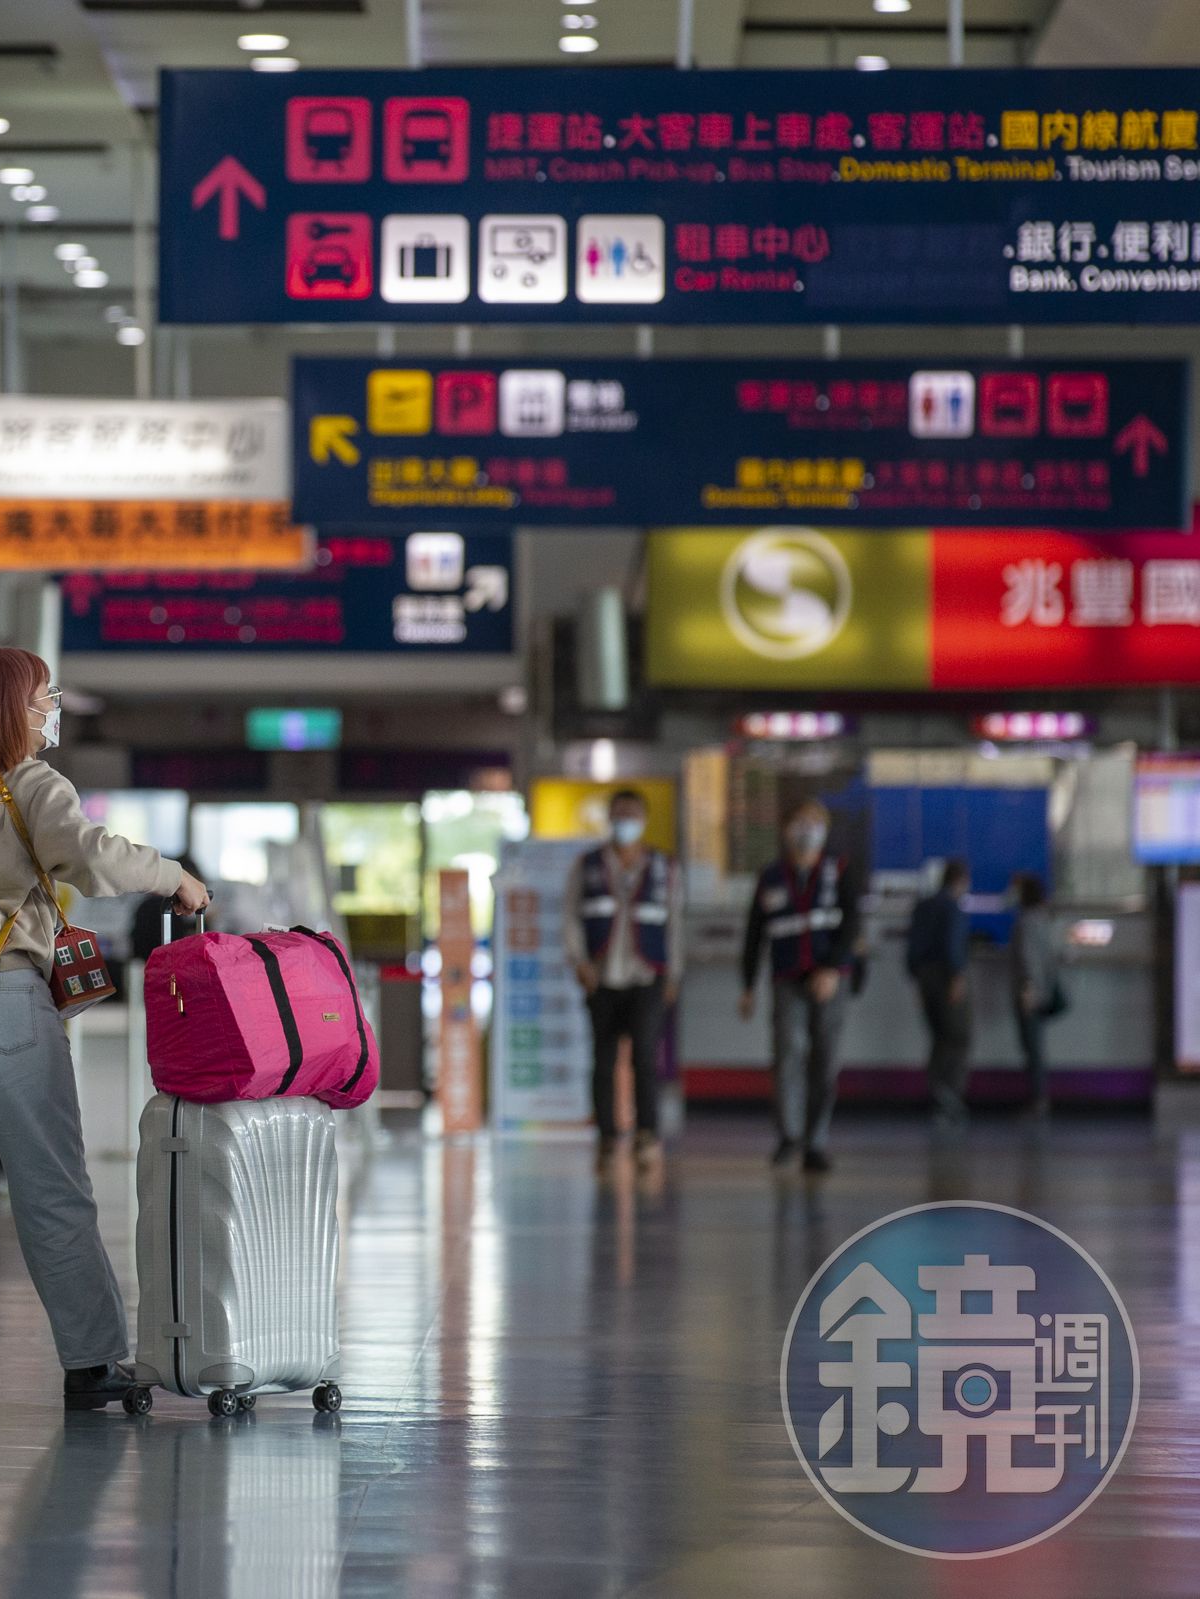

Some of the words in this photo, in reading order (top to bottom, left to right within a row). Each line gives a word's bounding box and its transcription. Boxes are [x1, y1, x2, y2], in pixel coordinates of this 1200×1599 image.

[839, 155, 950, 182] Domestic
[1065, 155, 1161, 182] Tourism
[674, 267, 716, 292] Car
[1002, 557, 1200, 628] 兆豐國
